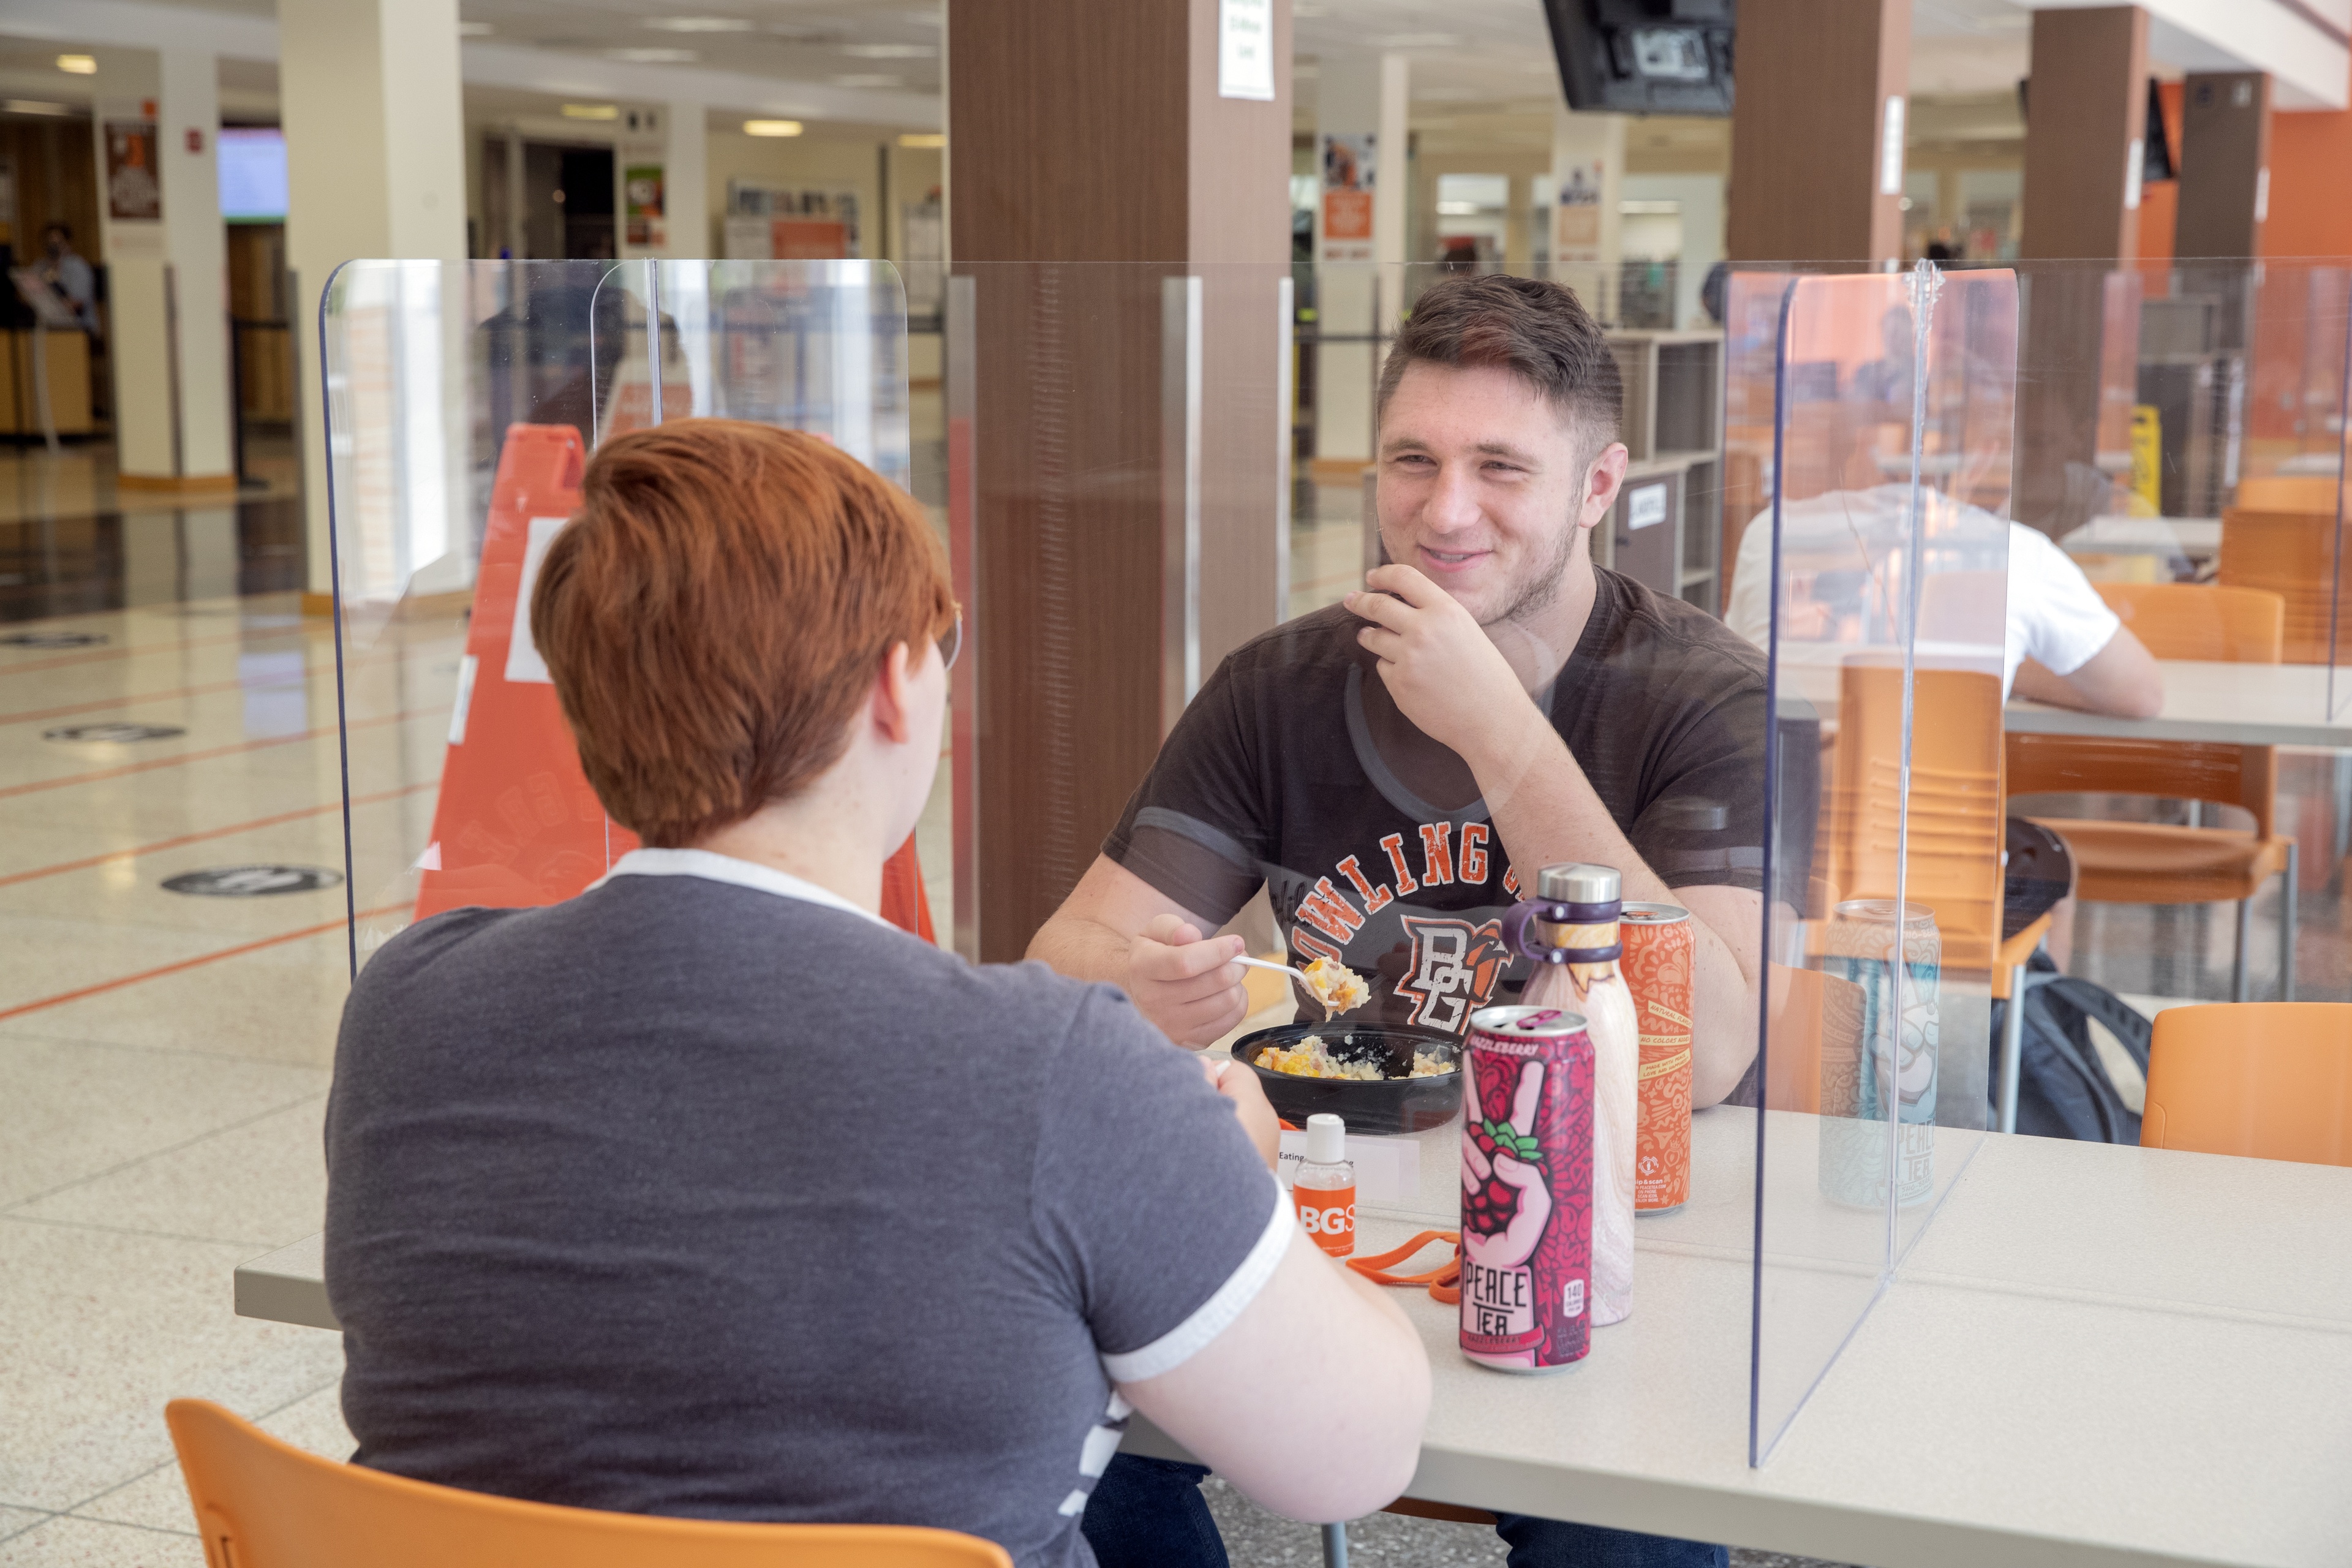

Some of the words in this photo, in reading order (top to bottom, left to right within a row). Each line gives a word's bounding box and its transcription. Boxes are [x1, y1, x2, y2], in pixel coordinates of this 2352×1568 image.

[1291, 821, 1489, 971] OWLING
[1650, 1005, 1676, 1019] NATURAL
[1904, 1152, 1932, 1181] TEA
[1466, 1262, 1527, 1306] PEACE
[1568, 1283, 1582, 1298] 140
[1473, 1302, 1514, 1335] TEA
